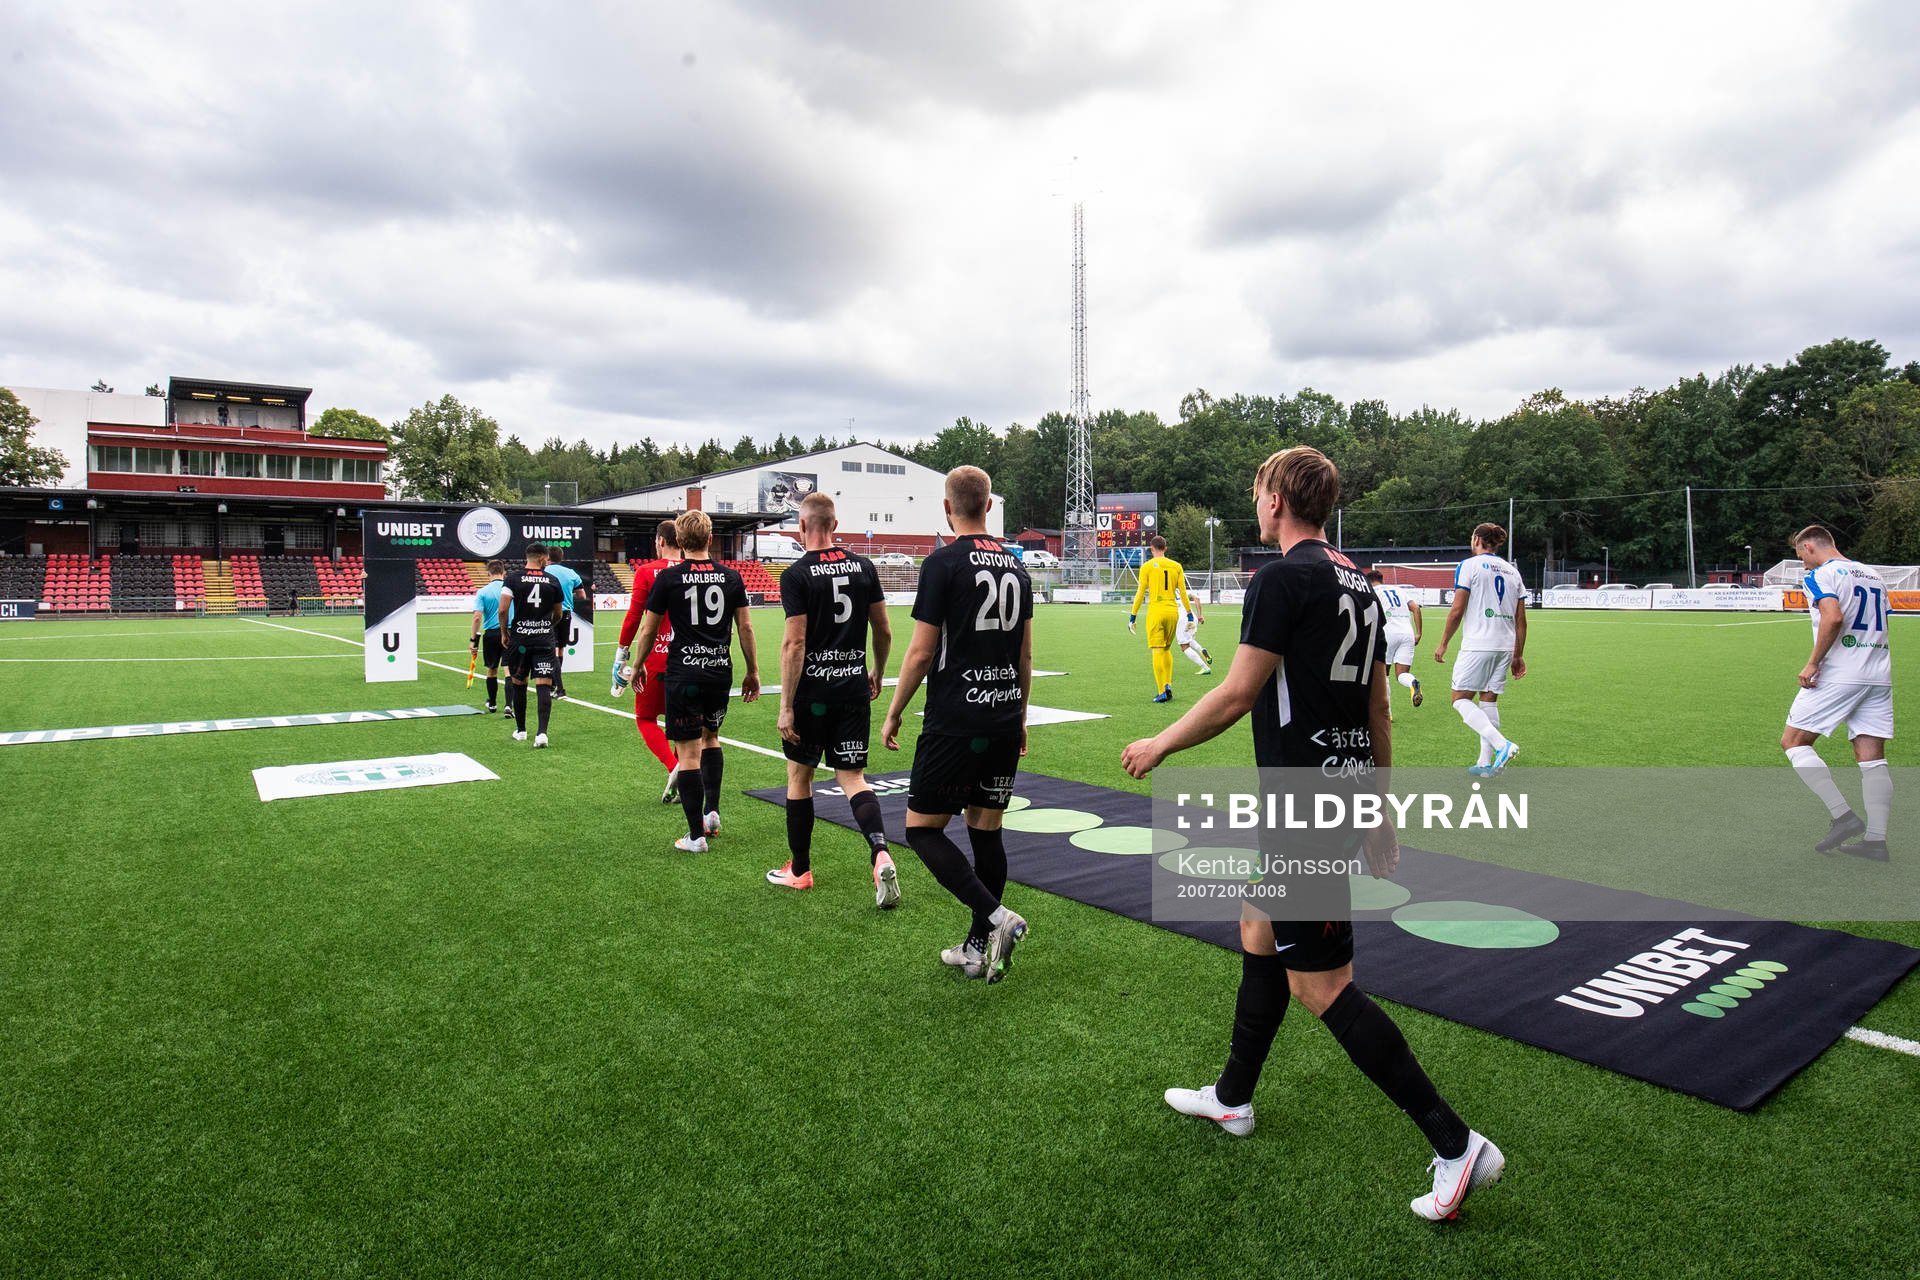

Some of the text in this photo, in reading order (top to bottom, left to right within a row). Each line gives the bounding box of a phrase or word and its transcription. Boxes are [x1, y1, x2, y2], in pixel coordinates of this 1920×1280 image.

[51, 500, 60, 508] C
[377, 522, 445, 537] UNIBET
[522, 526, 583, 540] UNIBET
[974, 539, 1003, 552] ABB
[820, 550, 847, 562] ABB
[969, 551, 1018, 569] CUSTOVIC
[690, 563, 714, 571] ABB
[810, 560, 862, 577] ENGSTRÖM
[521, 575, 550, 583] SABETKAR
[682, 573, 726, 584] KARLBERG
[1163, 570, 1168, 591] 1
[1334, 565, 1371, 594] SKOGH
[527, 583, 541, 608] 4
[832, 576, 853, 624] 5
[975, 569, 1021, 632] 20
[1383, 589, 1401, 608] 13
[684, 584, 725, 626] 19
[1852, 585, 1883, 632] 21
[382, 632, 400, 652] U
[1330, 593, 1379, 685] 21
[806, 664, 864, 682] Carpenter
[965, 684, 1022, 708] Carpente
[840, 741, 864, 751] TEXAS
[1554, 927, 1751, 1018] UNIBET
